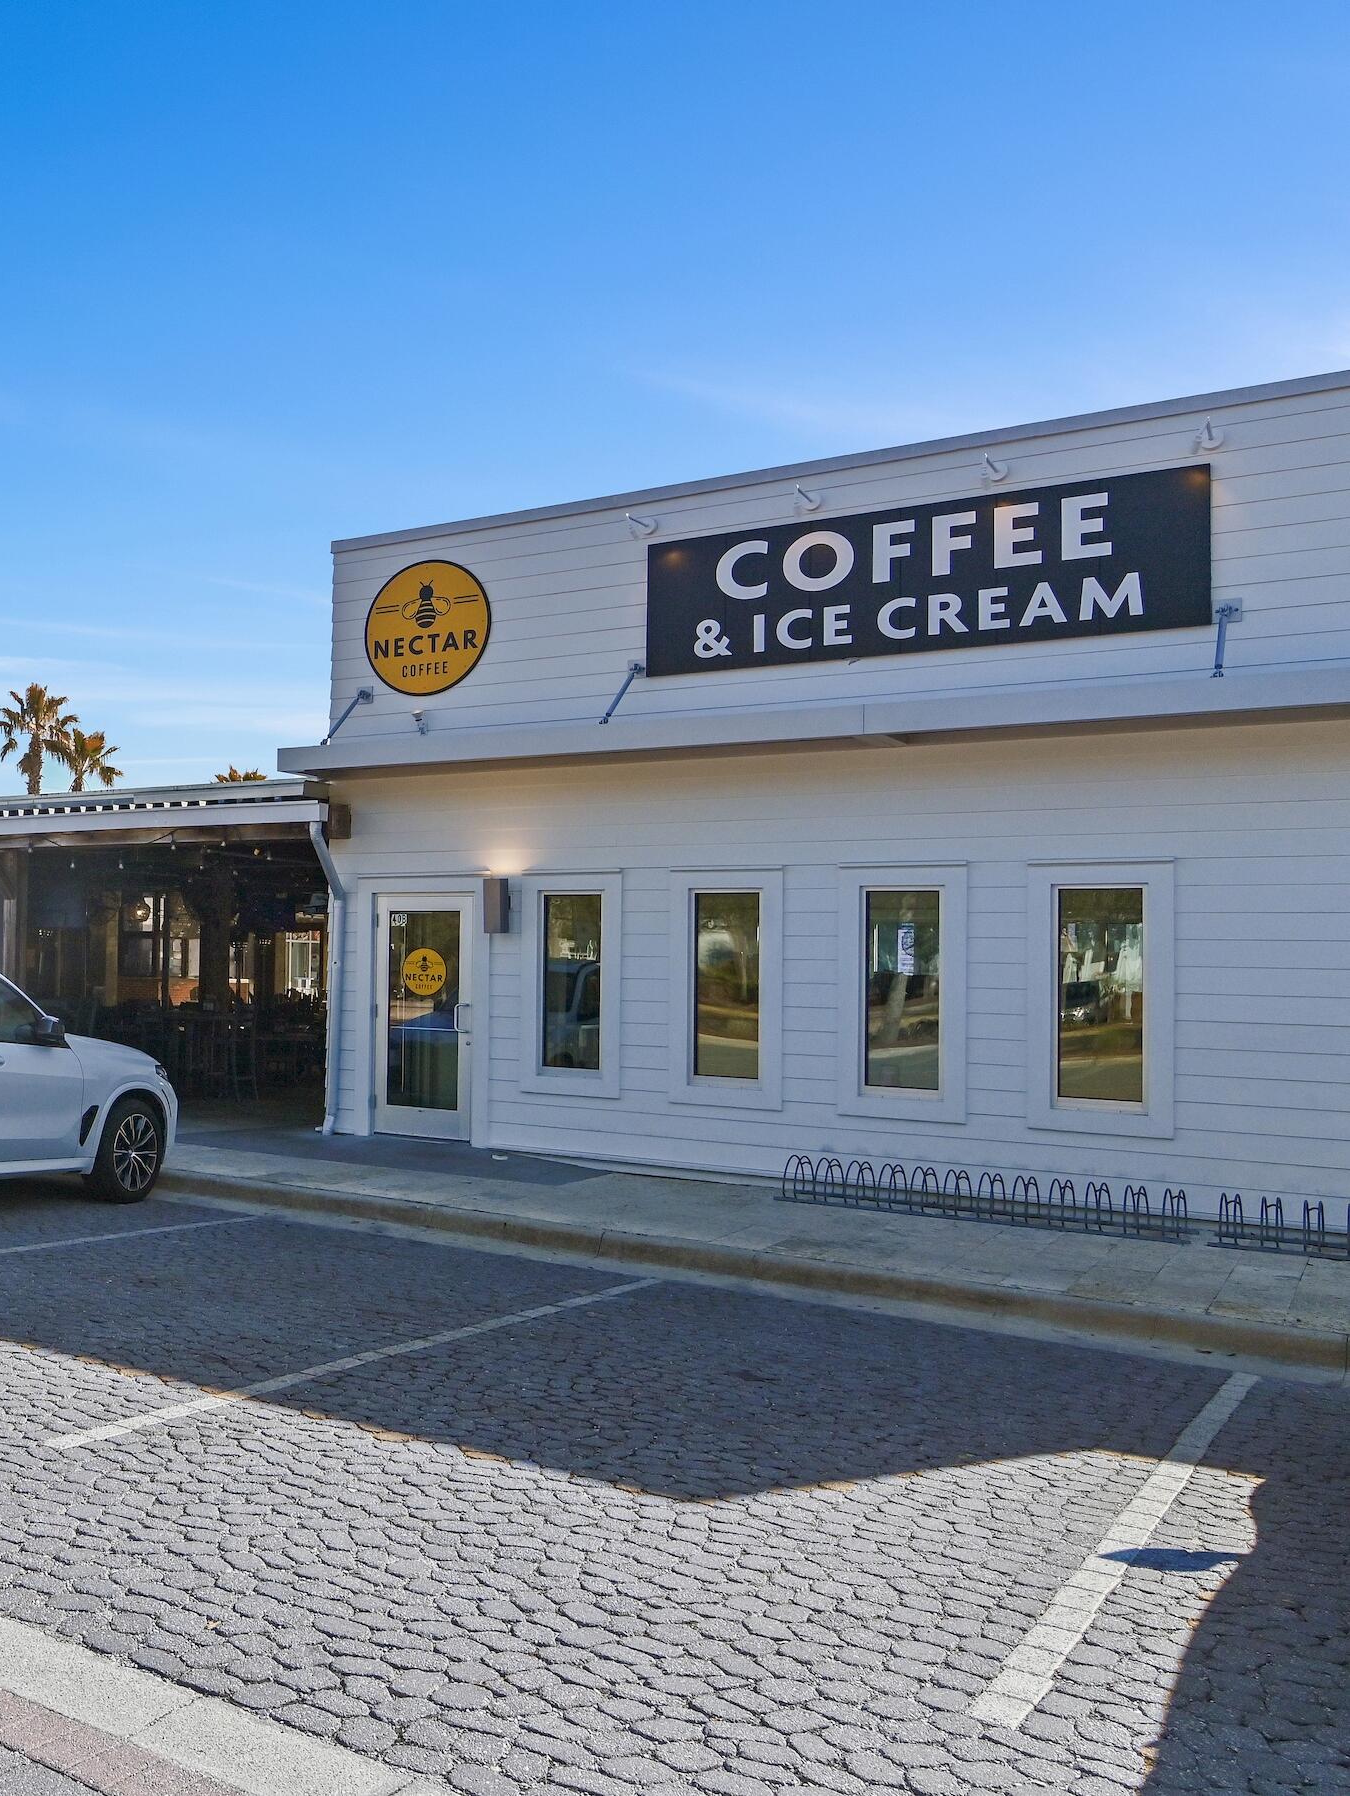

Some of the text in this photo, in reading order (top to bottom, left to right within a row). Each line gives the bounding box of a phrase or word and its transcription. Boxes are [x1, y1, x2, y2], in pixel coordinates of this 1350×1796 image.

[715, 491, 1113, 601] COFFEE
[693, 571, 1145, 659] & ICE CREAM
[374, 629, 479, 660] NECTAR
[402, 661, 448, 678] COFFEE
[405, 973, 443, 982] NECTAR
